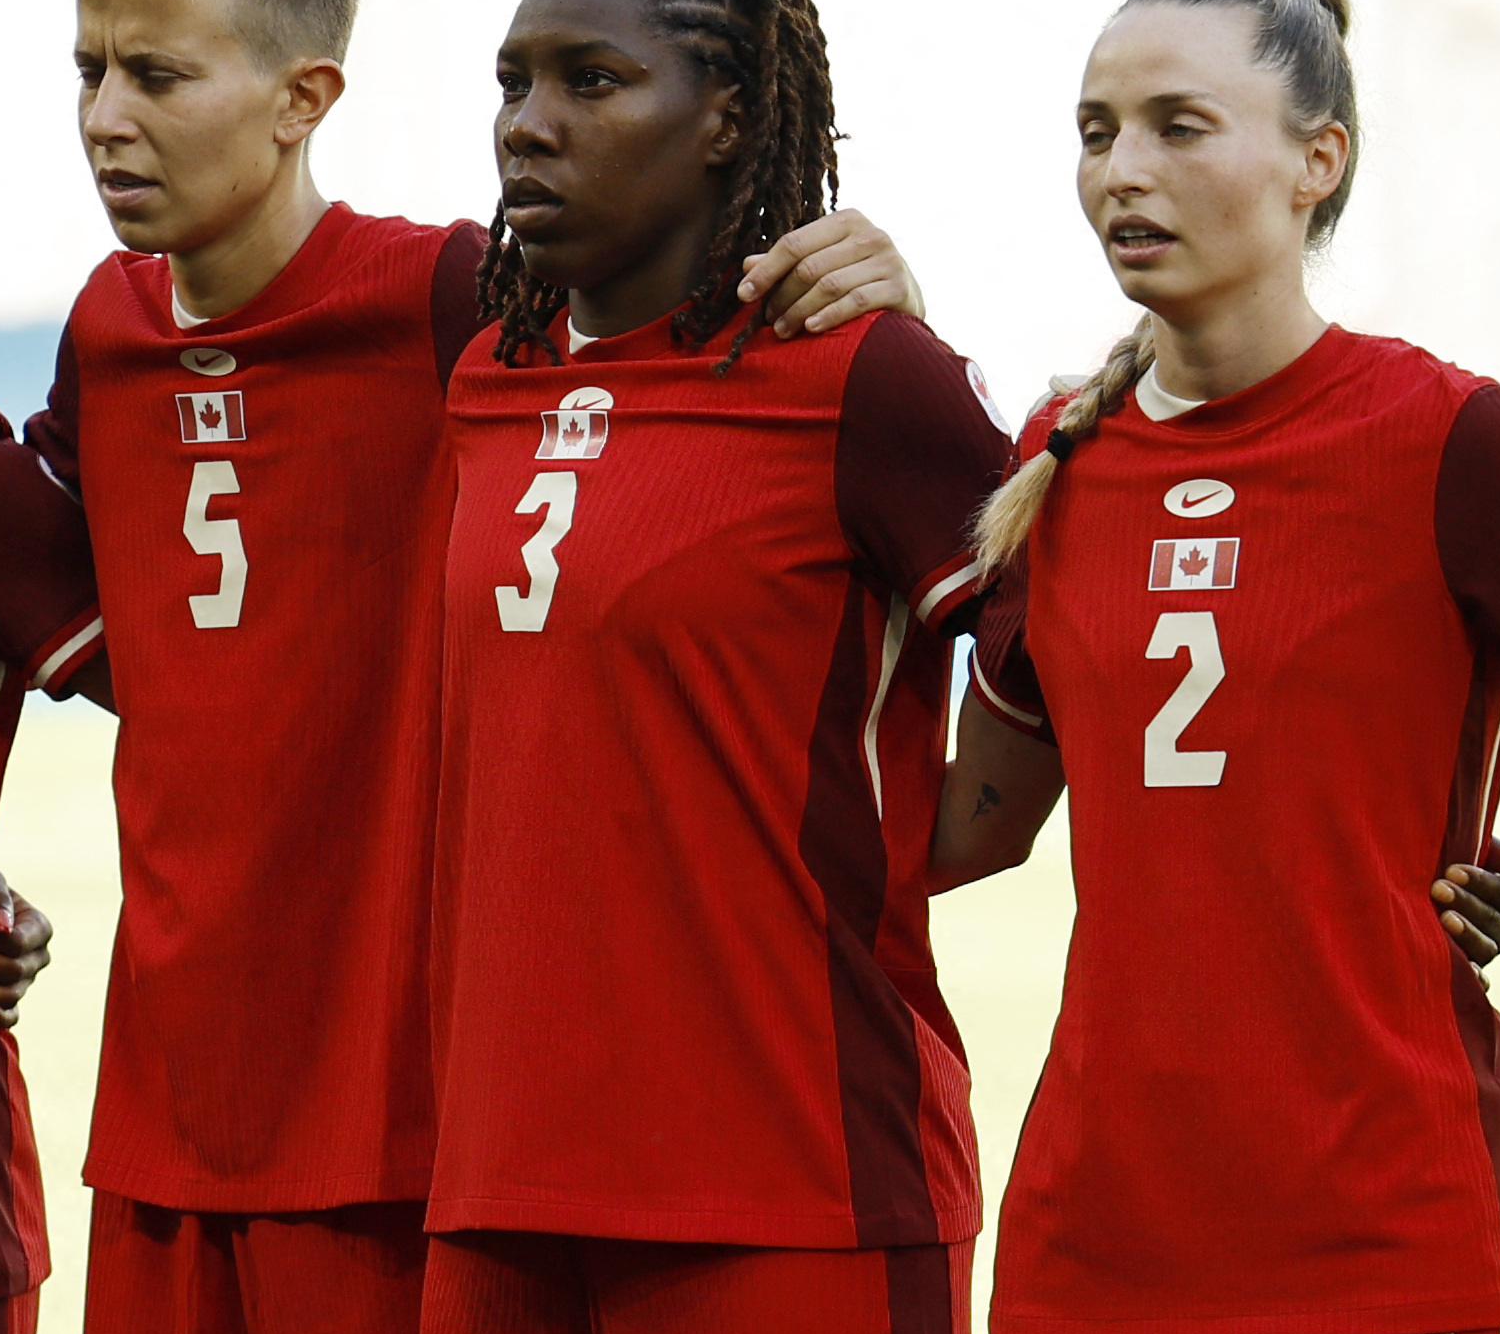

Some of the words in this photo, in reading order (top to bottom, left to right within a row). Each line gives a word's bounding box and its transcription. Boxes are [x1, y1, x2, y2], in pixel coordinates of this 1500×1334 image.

[182, 461, 248, 628] 5
[494, 471, 577, 633] 3
[1144, 611, 1226, 787] 2
